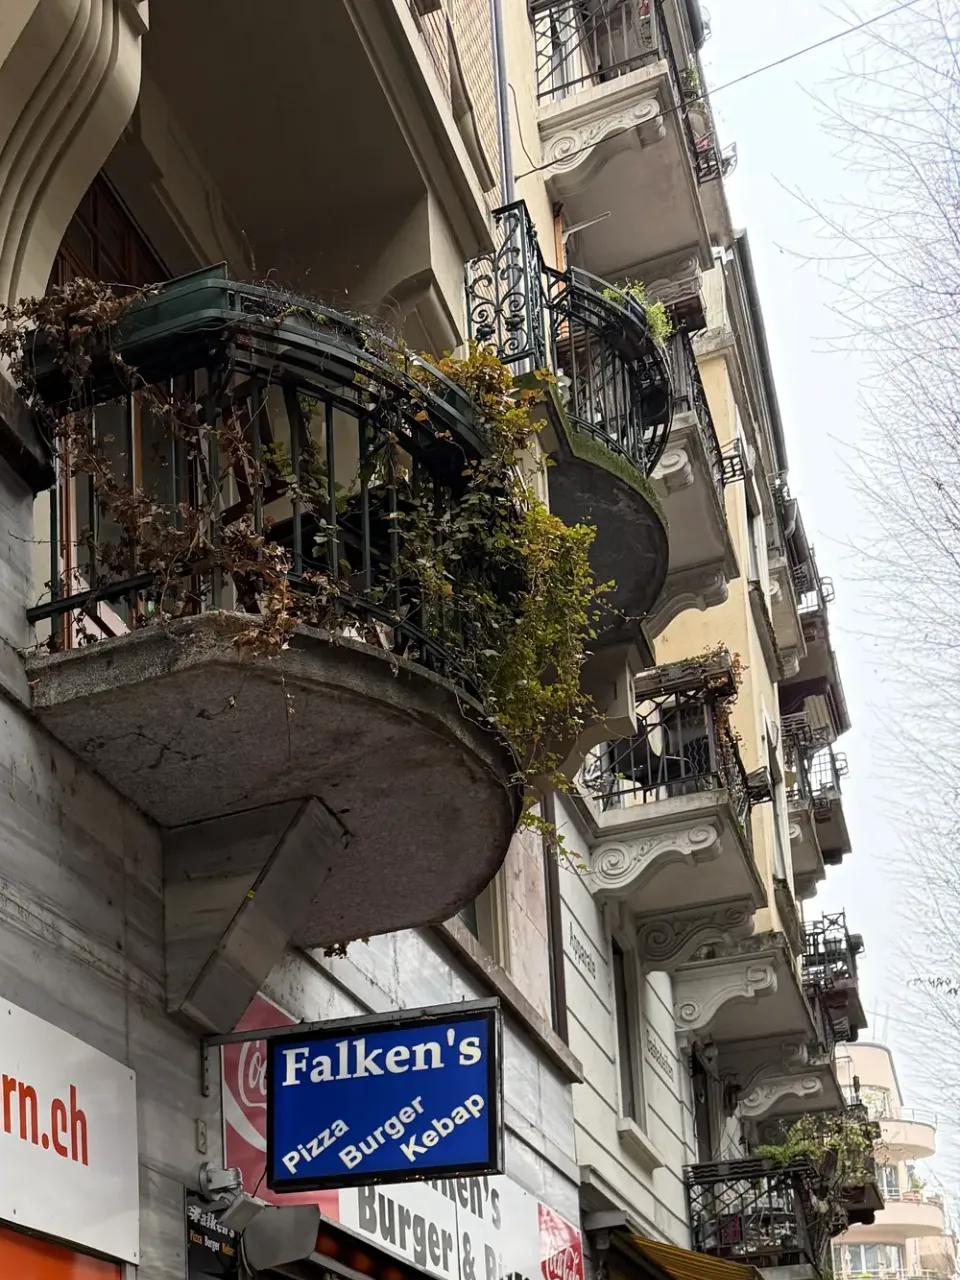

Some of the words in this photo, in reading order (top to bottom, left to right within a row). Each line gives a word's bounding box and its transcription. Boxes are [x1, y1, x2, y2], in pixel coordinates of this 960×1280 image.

[281, 1028, 482, 1087] Falken's
[281, 1118, 350, 1175] Pizza
[338, 1095, 425, 1170] Burger
[398, 1092, 485, 1163] Kebap
[357, 1184, 453, 1272] Burger
